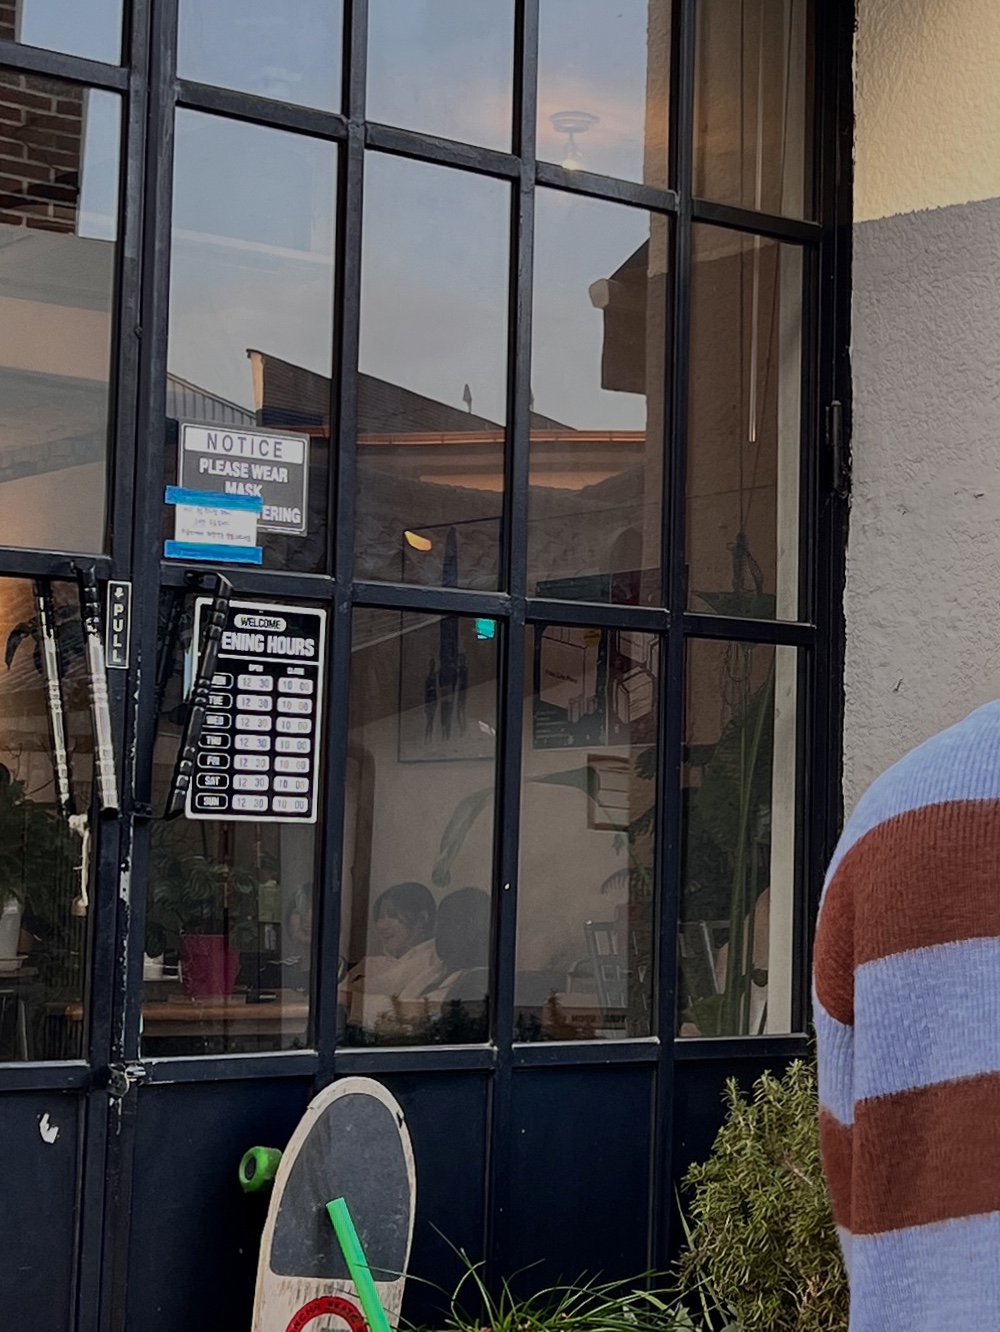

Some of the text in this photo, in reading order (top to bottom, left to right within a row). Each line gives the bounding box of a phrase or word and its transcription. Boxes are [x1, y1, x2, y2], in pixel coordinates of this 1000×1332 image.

[207, 432, 283, 458] NOTICE
[199, 457, 288, 483] PLEASE WEAR
[225, 481, 263, 498] MASK
[258, 505, 301, 524] ERING
[112, 603, 124, 663] PULL
[240, 616, 282, 629] WELCOME
[222, 631, 315, 657] ENING HOURS
